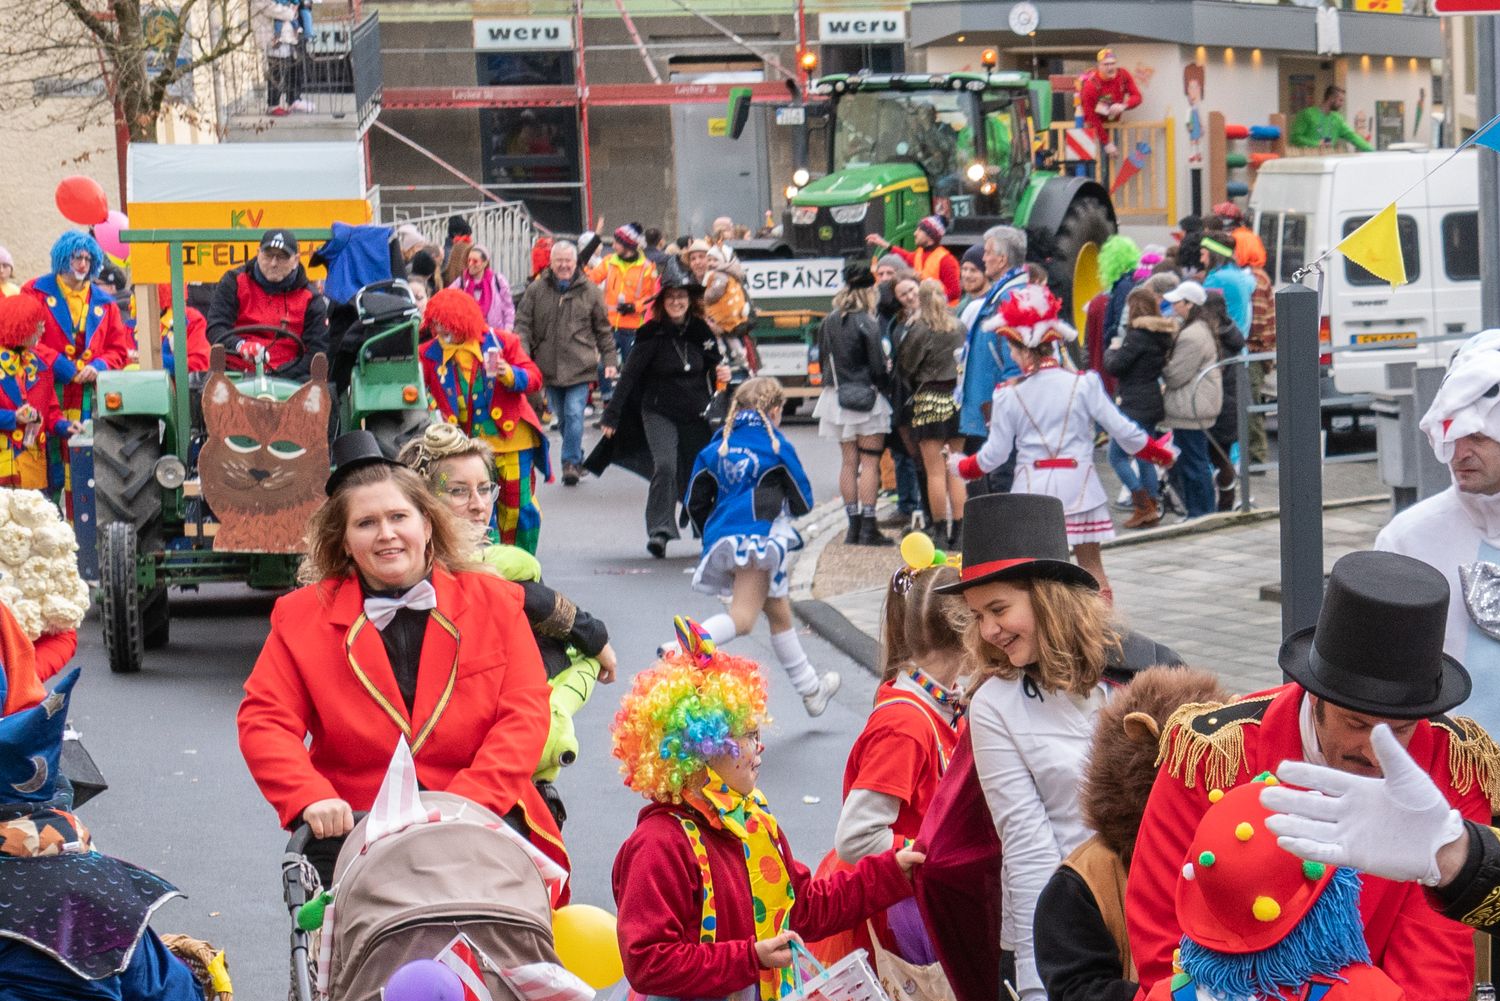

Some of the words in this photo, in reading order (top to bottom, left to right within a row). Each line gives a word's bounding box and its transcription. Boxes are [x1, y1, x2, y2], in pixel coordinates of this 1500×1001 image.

[828, 20, 897, 33] weru
[489, 27, 559, 41] weru
[231, 208, 263, 228] KV
